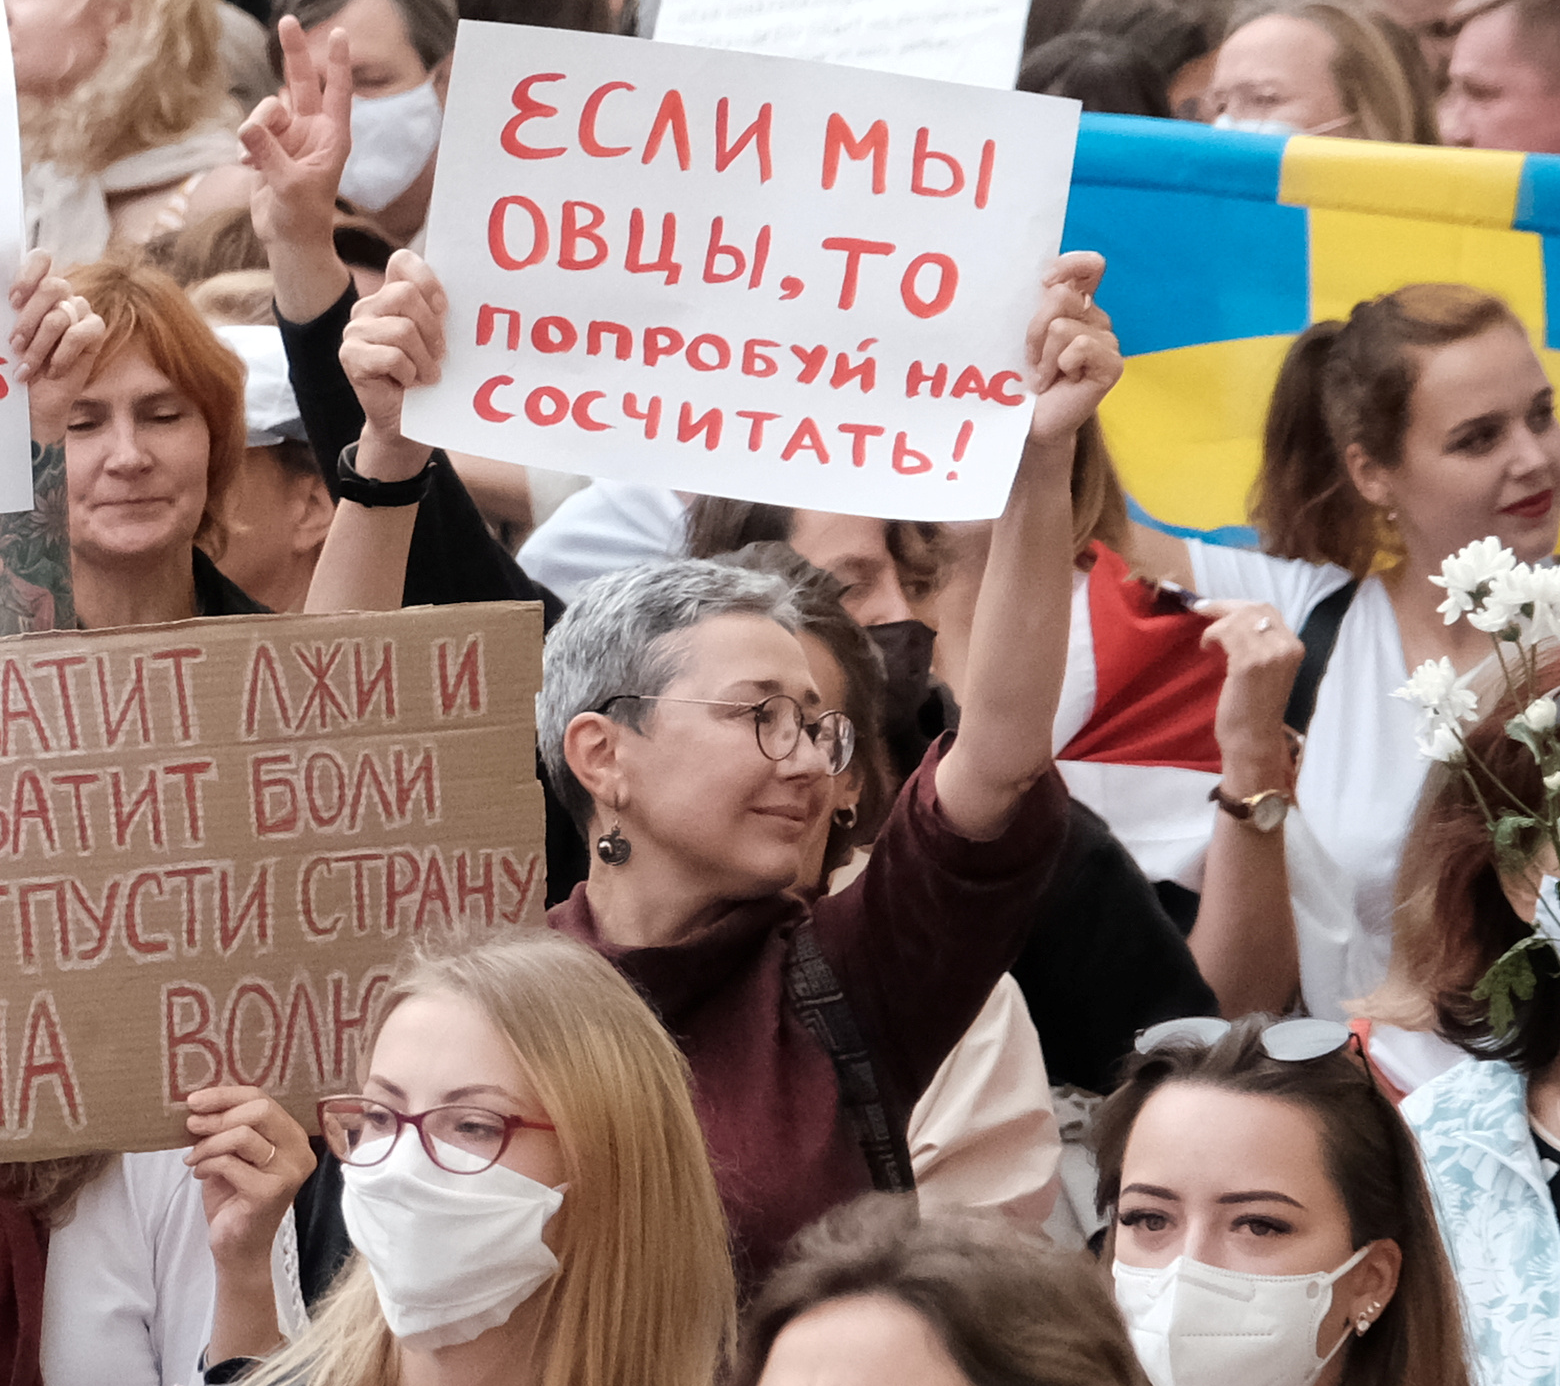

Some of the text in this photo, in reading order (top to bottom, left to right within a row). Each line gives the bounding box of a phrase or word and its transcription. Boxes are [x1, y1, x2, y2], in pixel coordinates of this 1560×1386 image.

[500, 72, 996, 210] ЕСЛИ МЫ
[487, 195, 959, 319] ОВЦЫ, ТО
[475, 303, 1026, 406] ПОПРОБУЙ НАС
[472, 375, 974, 481] СОСЧИТАТЬ!
[244, 638, 397, 735] ЛЖИ
[436, 636, 484, 714] И
[251, 747, 438, 835] БОЛИ
[302, 851, 542, 939] СТРАНУ
